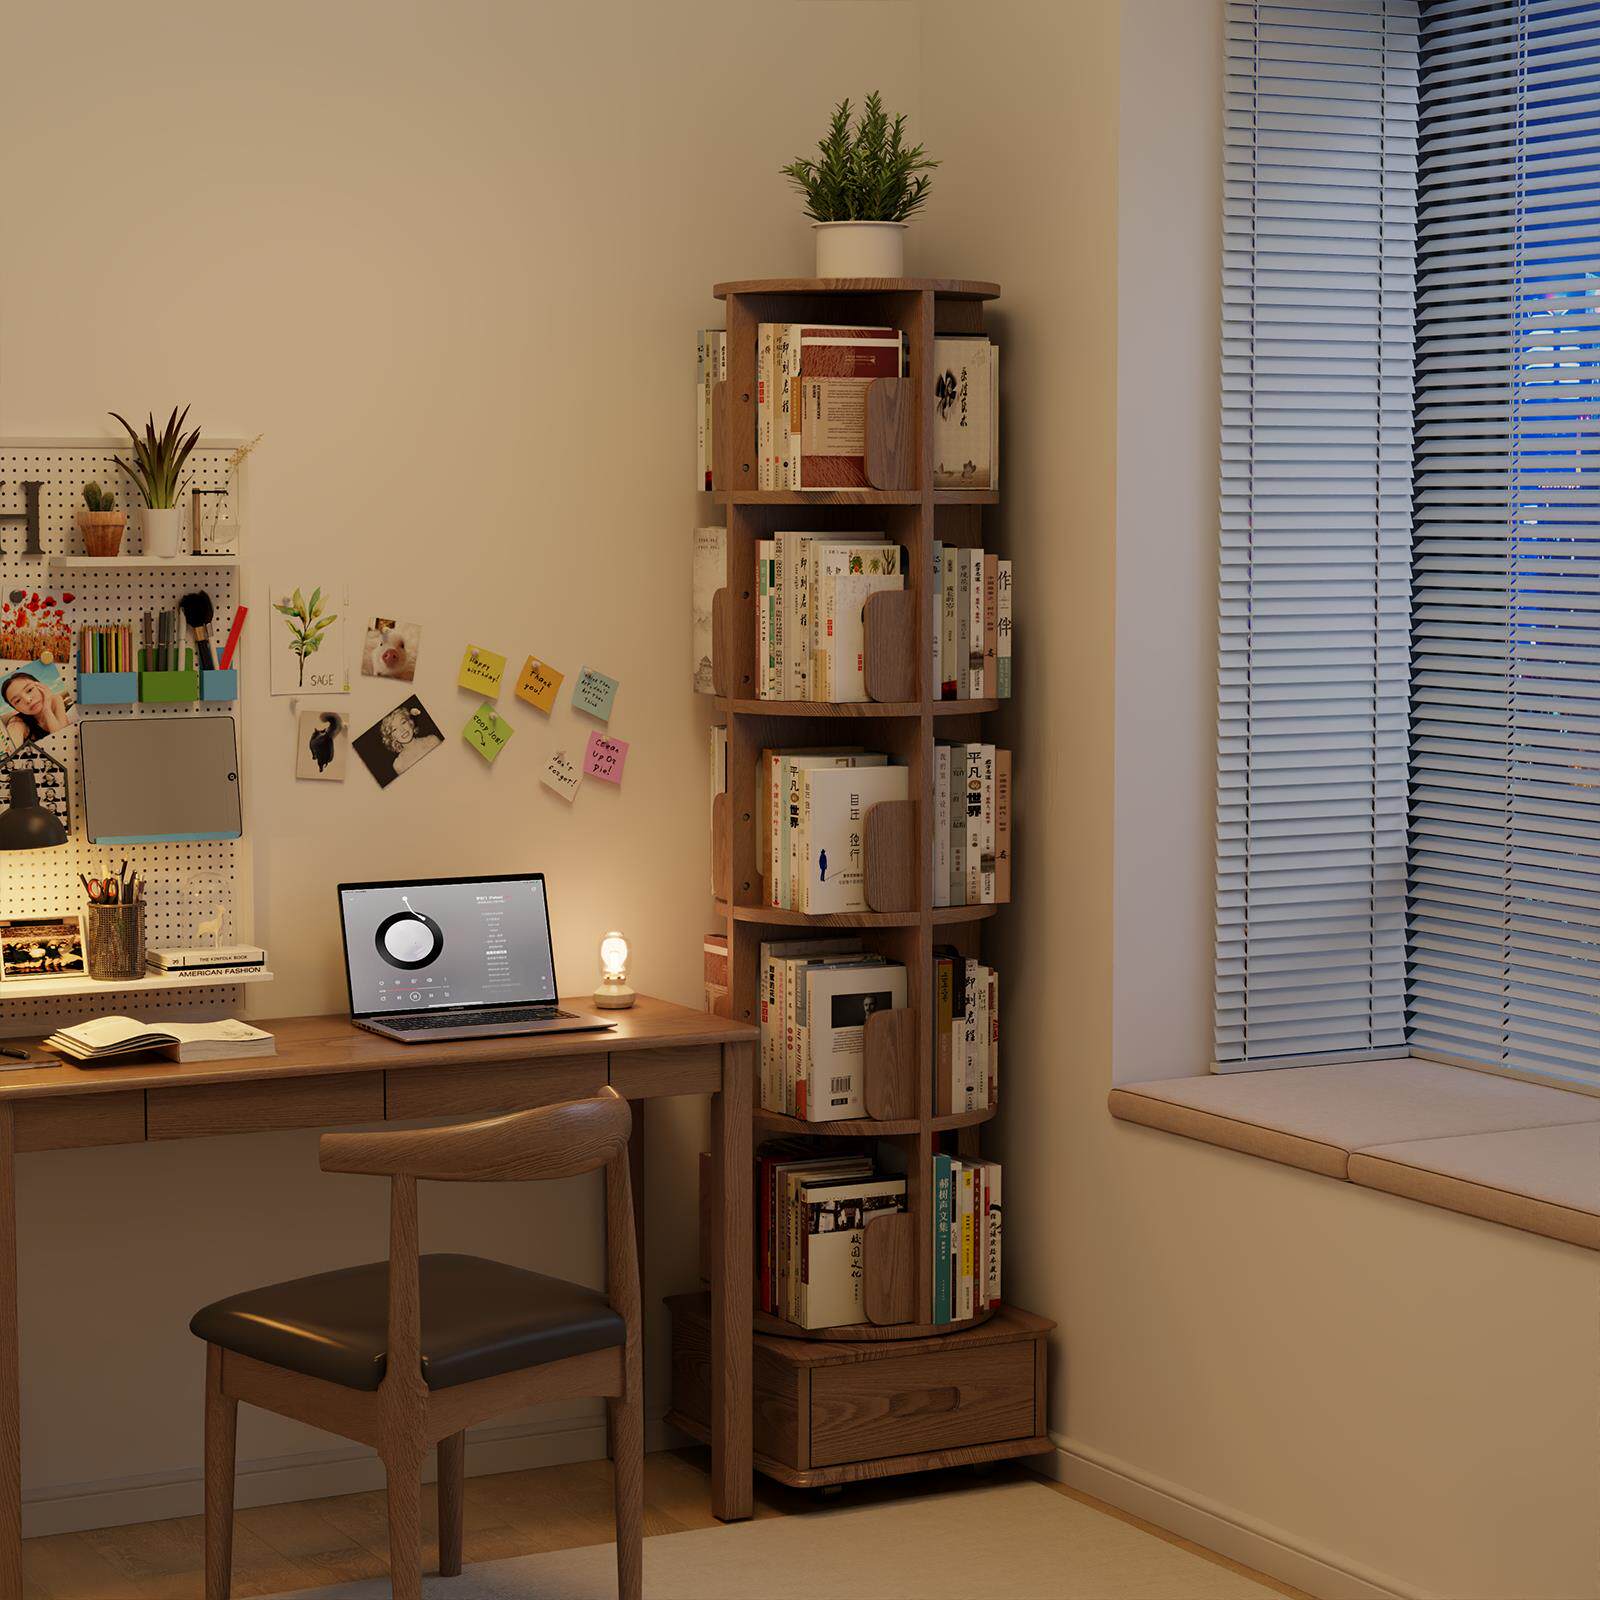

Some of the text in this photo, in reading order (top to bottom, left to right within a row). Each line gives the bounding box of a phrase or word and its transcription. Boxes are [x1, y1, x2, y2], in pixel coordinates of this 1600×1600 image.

[998, 571, 1012, 637] 作伴
[311, 674, 335, 686] SAGE
[530, 670, 553, 688] Thank
[233, 953, 248, 961] BOOK
[178, 966, 261, 979] AMERICAN FASHION
[850, 1232, 863, 1279] 校园文化
